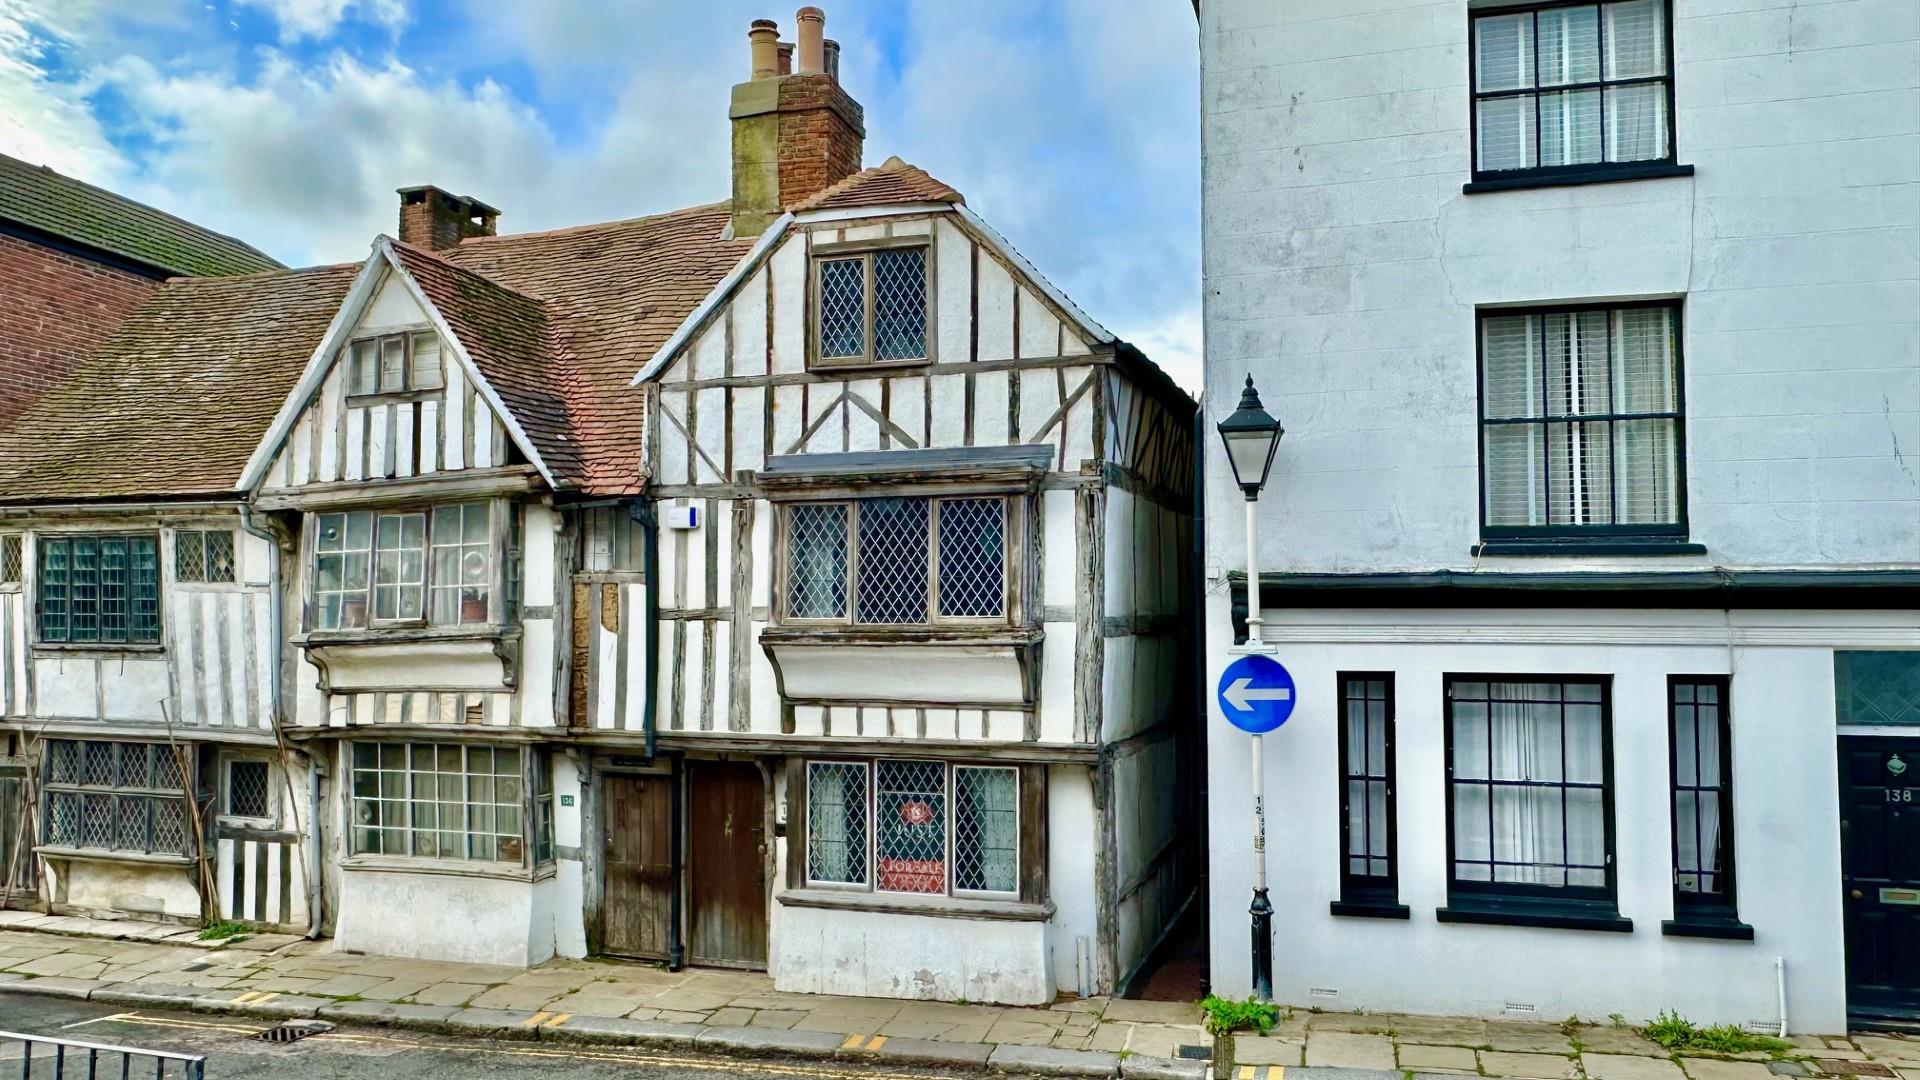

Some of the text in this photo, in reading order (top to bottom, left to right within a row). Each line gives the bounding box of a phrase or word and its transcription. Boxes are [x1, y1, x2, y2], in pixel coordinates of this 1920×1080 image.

[1884, 789, 1912, 802] 138
[897, 824, 936, 838] JUST
[889, 861, 943, 874] FOR SALE
